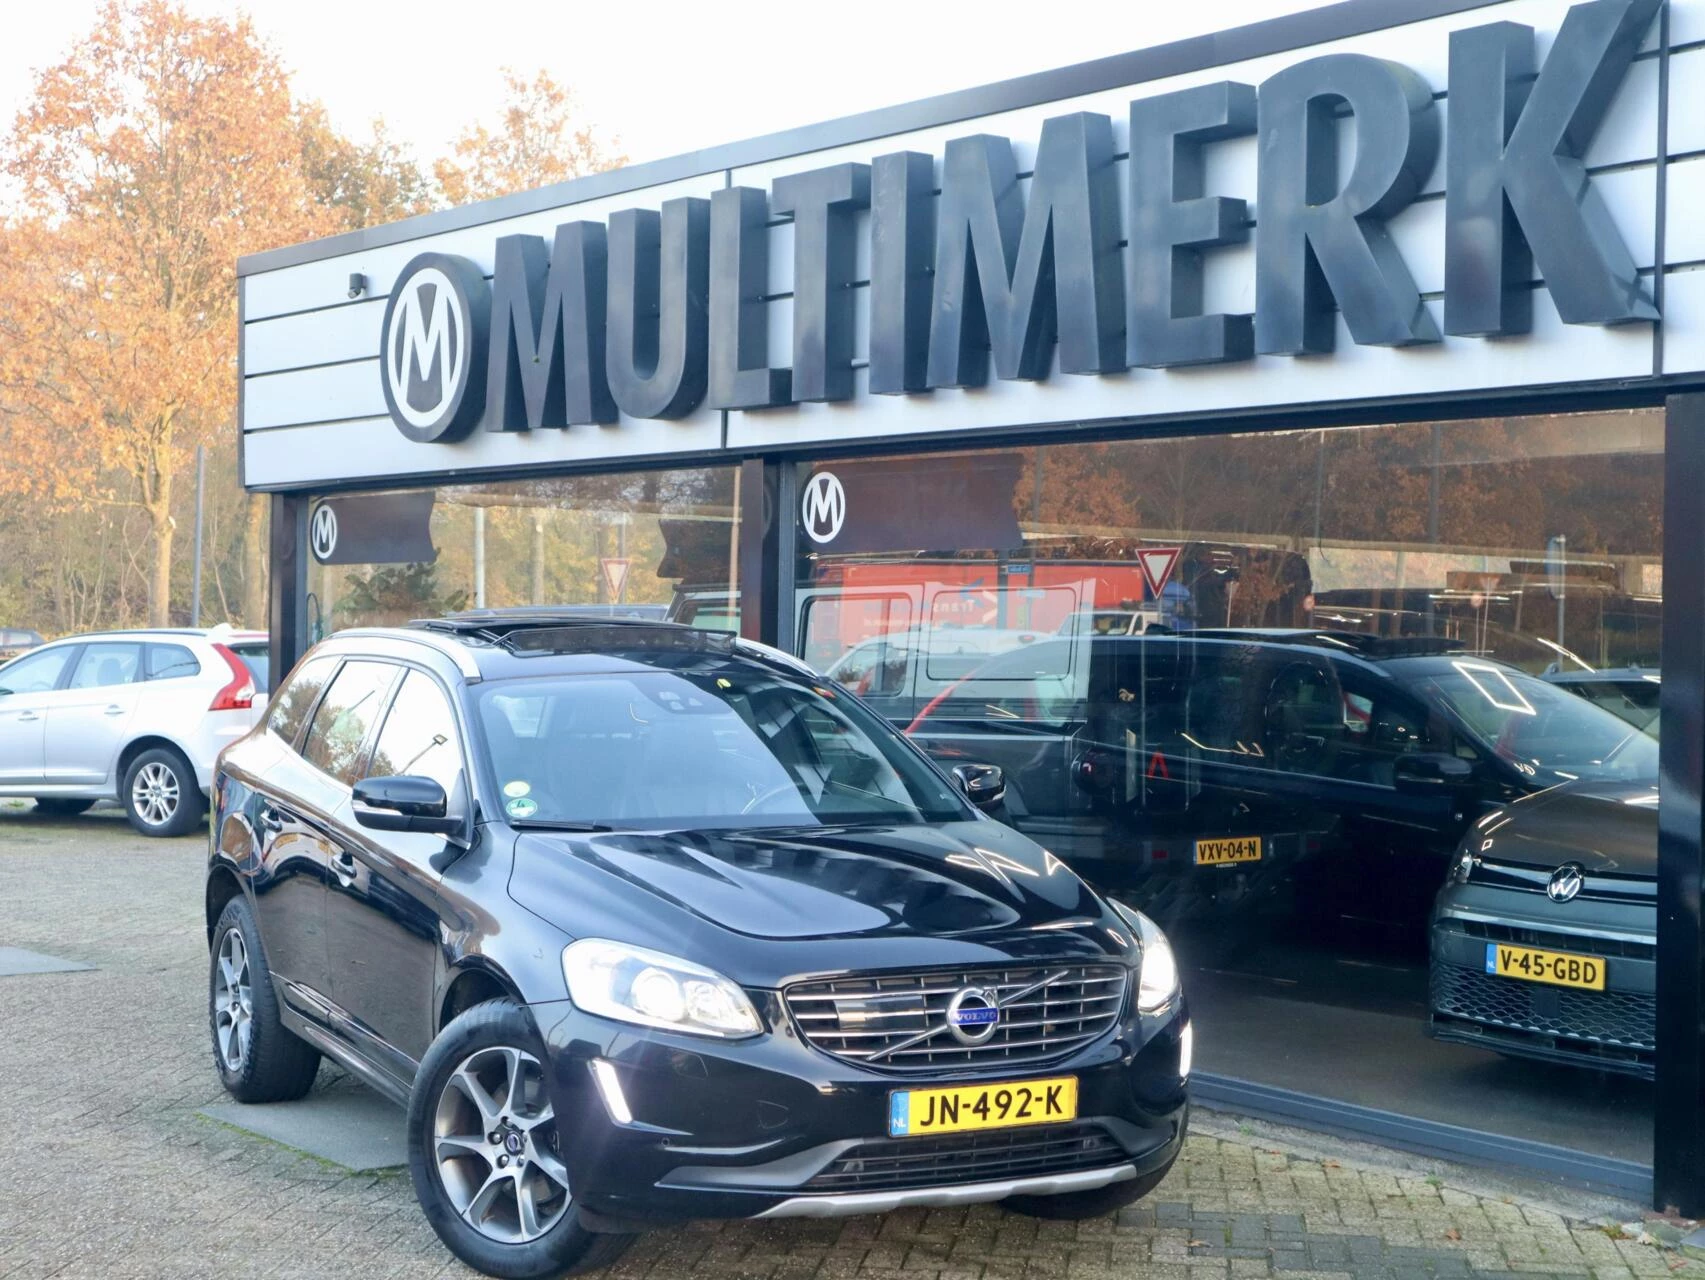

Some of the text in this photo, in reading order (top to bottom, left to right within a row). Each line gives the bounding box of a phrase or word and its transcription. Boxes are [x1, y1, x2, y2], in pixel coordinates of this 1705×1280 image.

[486, 0, 1659, 432] MULTIMERK
[1199, 840, 1257, 861] VXV-04-N
[1500, 948, 1597, 984] V-45-GBD
[955, 1010, 997, 1022] VOLVO
[919, 1084, 1064, 1127] JN-492-K
[893, 1117, 907, 1128] NL
